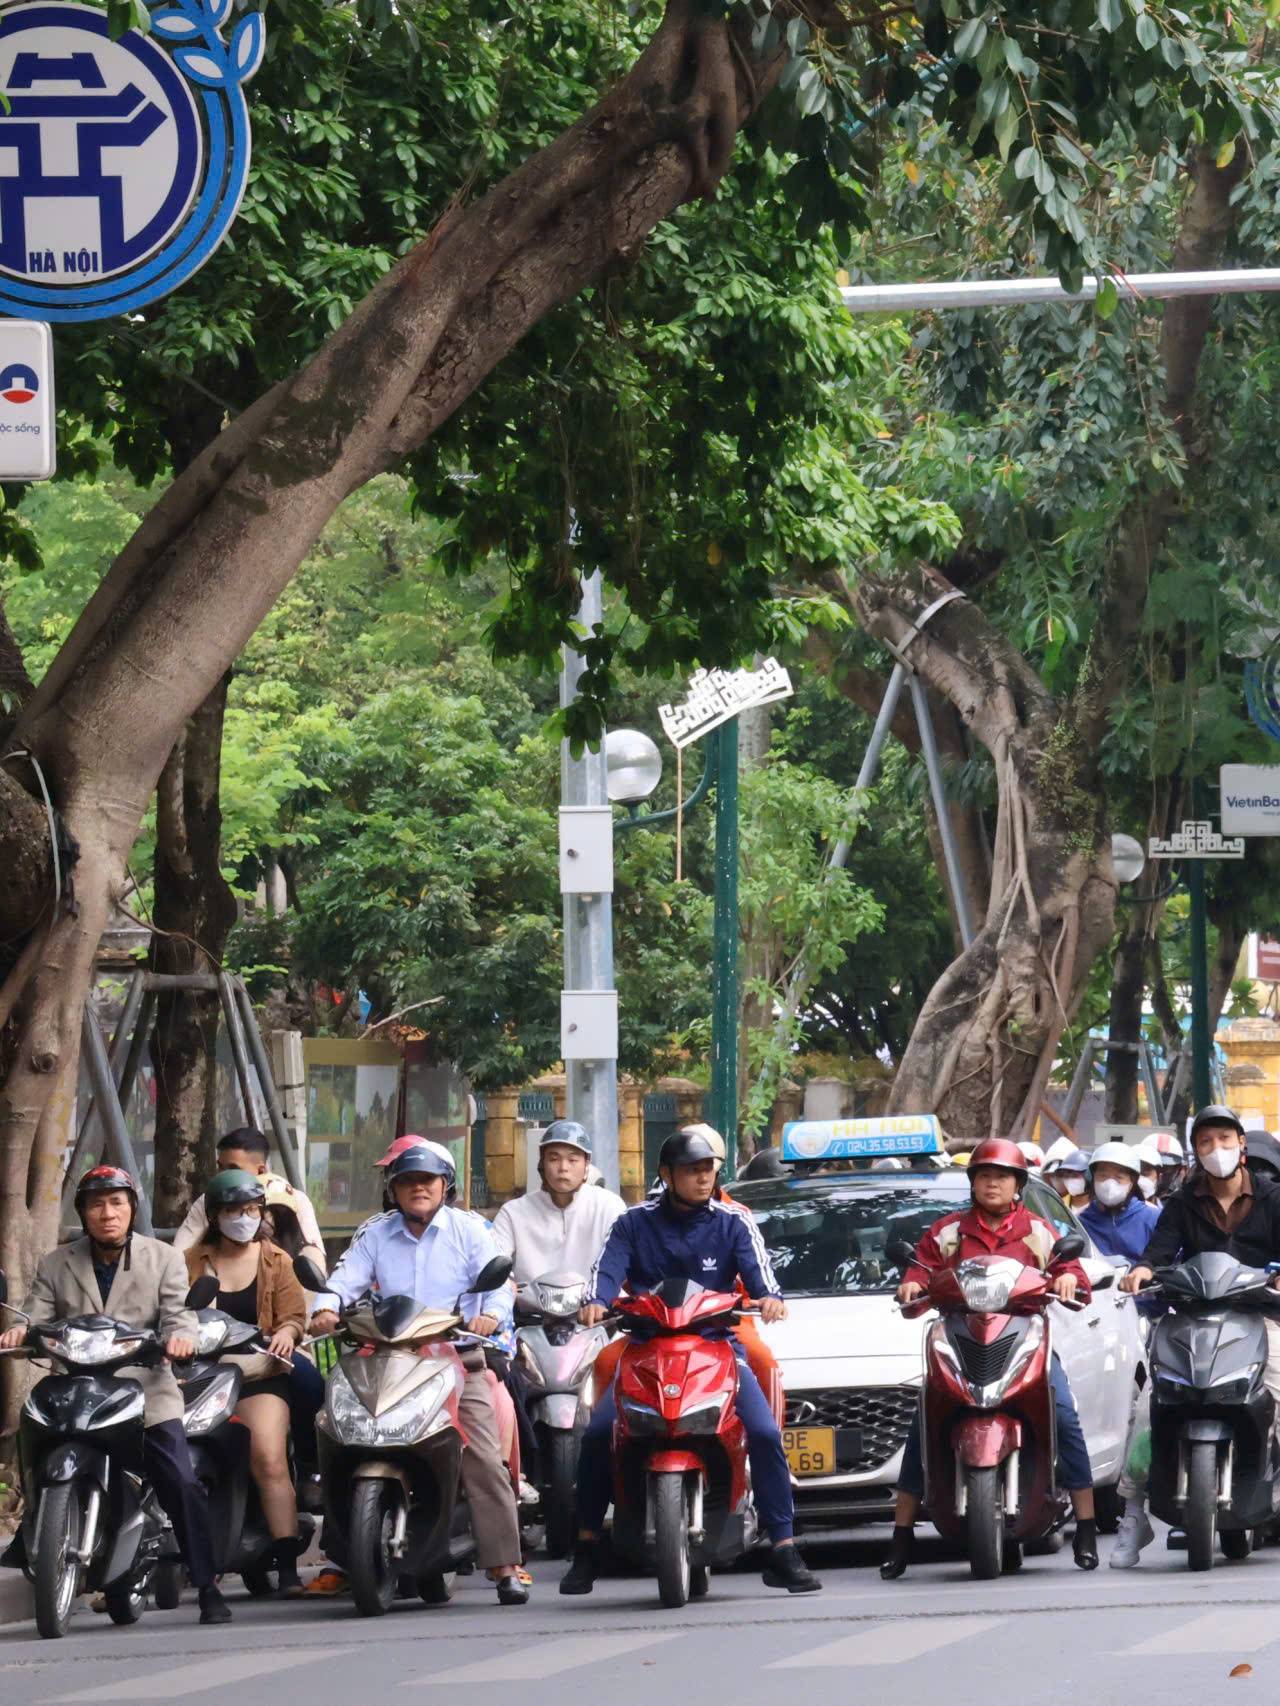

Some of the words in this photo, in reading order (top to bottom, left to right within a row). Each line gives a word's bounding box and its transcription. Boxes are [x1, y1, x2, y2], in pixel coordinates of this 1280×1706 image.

[29, 249, 57, 272] HÀ
[63, 248, 98, 276] NỘI
[15, 422, 40, 435] sống
